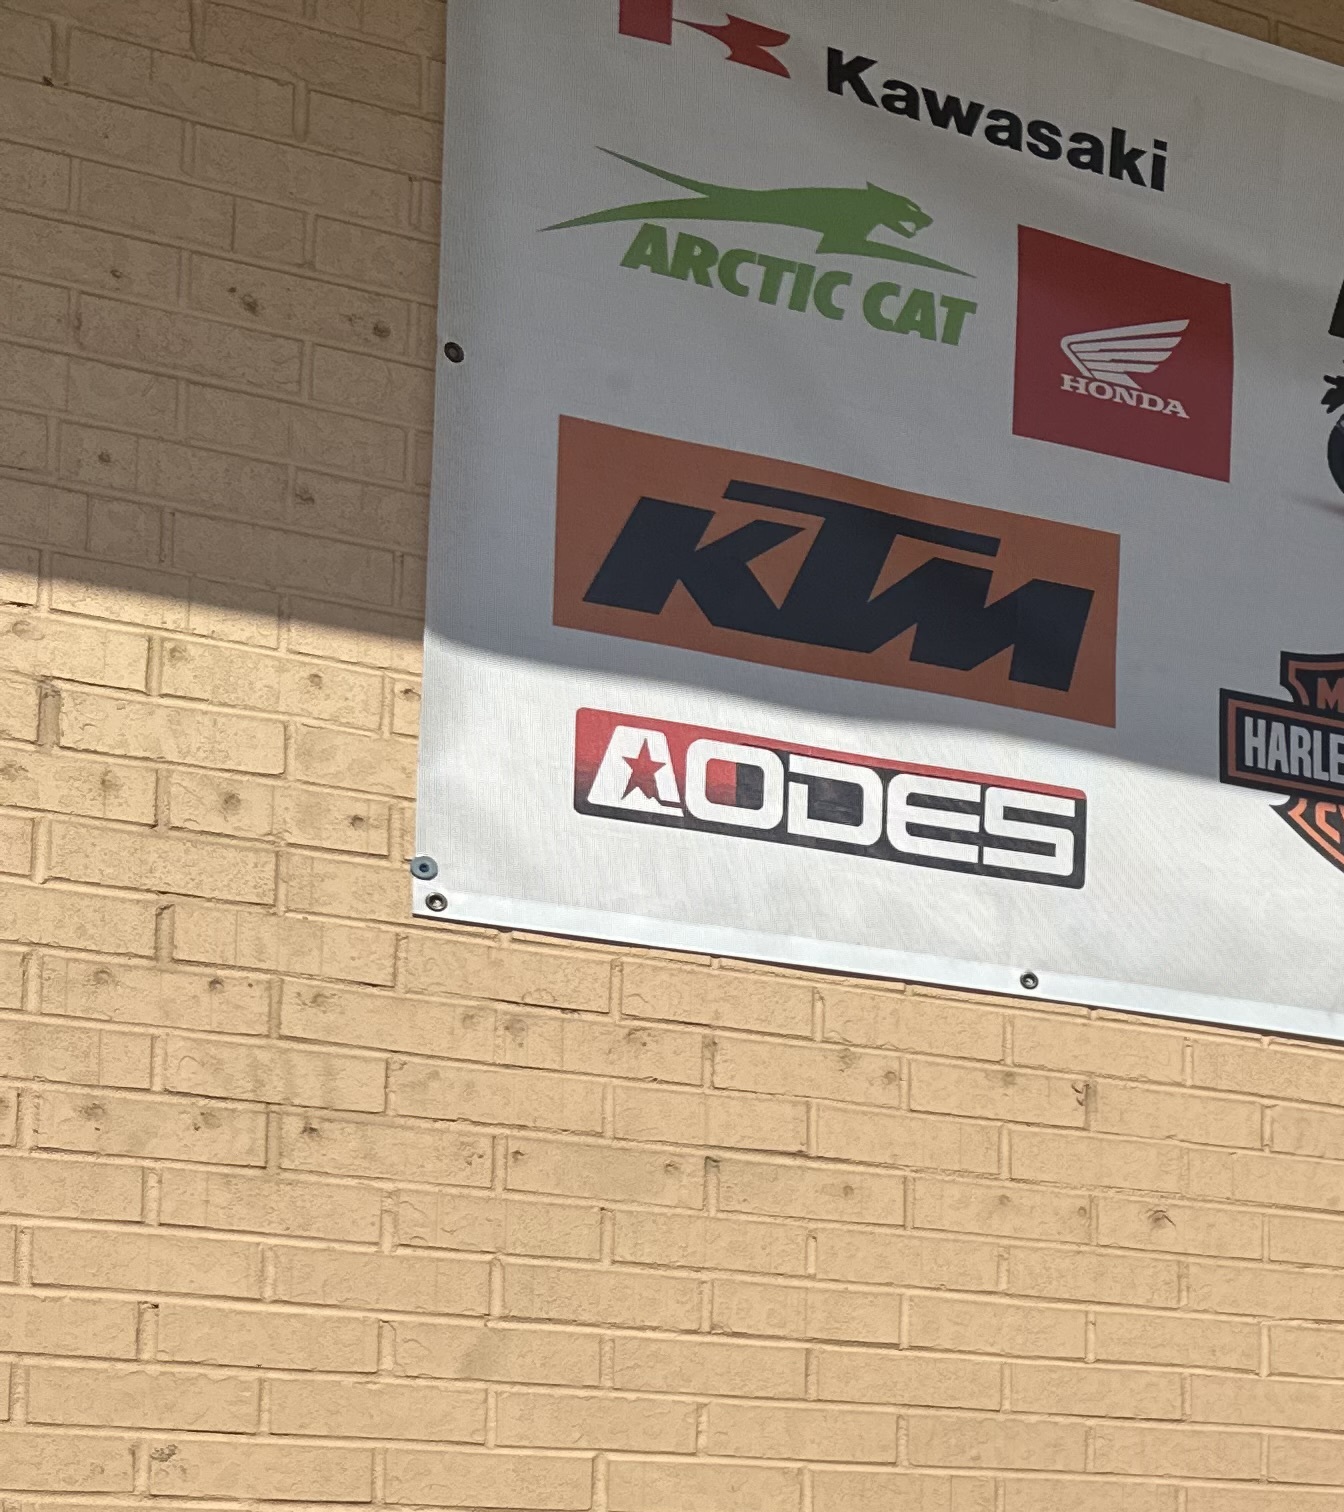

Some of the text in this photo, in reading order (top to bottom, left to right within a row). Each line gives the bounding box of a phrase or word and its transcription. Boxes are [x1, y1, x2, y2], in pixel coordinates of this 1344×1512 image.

[826, 46, 1168, 192] Kawasaki
[619, 222, 977, 347] ARCTIC CAT
[1059, 373, 1190, 420] HONDA
[583, 480, 1096, 693] KTM
[587, 725, 1076, 877] AODES
